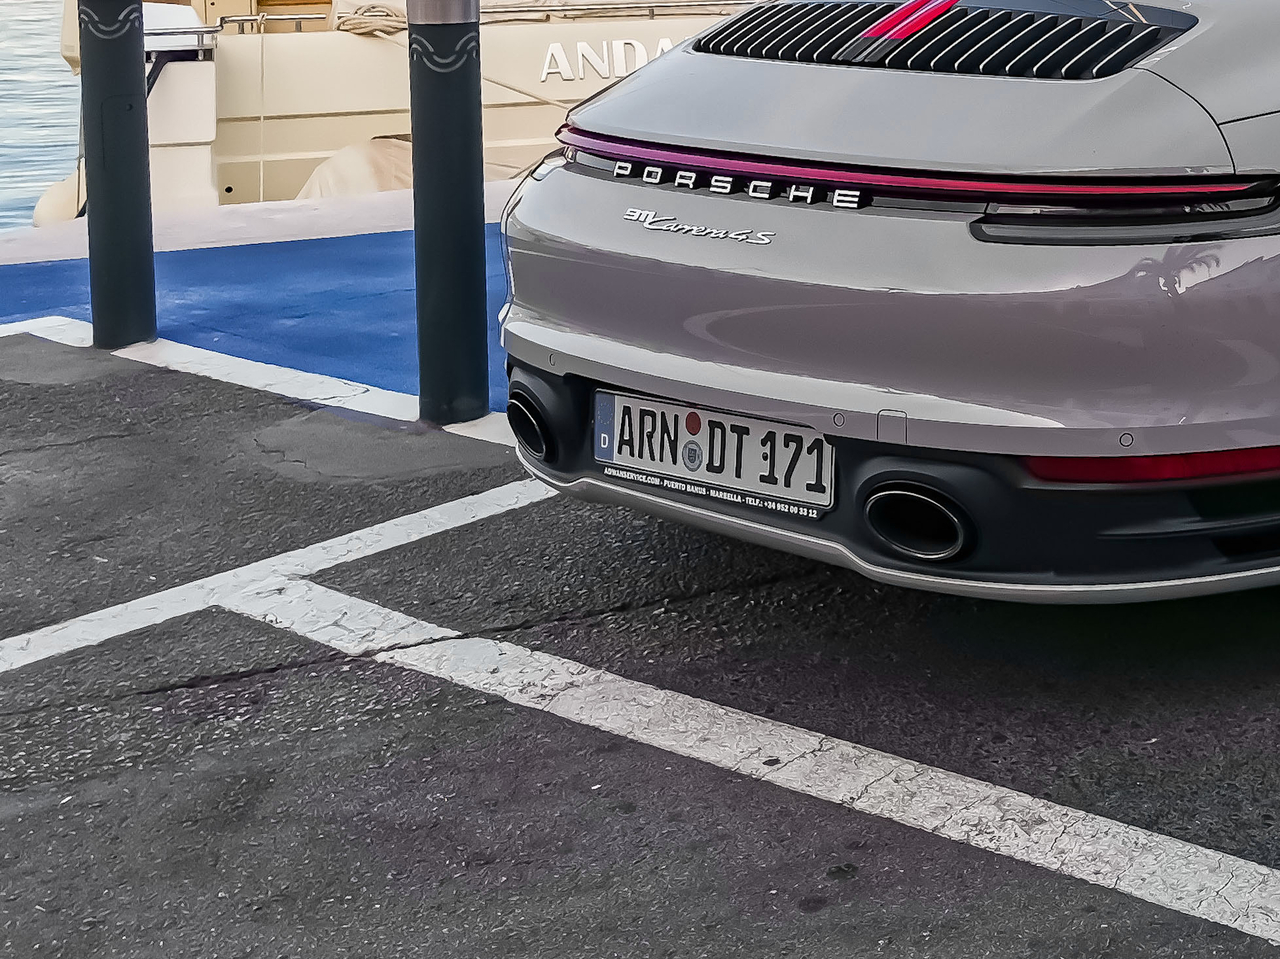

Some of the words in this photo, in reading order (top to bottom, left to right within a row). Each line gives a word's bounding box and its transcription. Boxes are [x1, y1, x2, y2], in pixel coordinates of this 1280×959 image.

[613, 161, 861, 208] PORSCHE
[623, 207, 657, 223] 911
[643, 216, 729, 240] Carrera
[600, 433, 609, 449] D
[617, 404, 679, 466] ARN
[706, 419, 750, 479] DT
[759, 430, 827, 494] 171
[663, 479, 686, 491] PUERTO
[710, 489, 742, 503] MARBELLA
[764, 501, 776, 510] +34
[777, 502, 789, 512] 952
[789, 505, 798, 514] 00
[808, 509, 818, 518] 12
